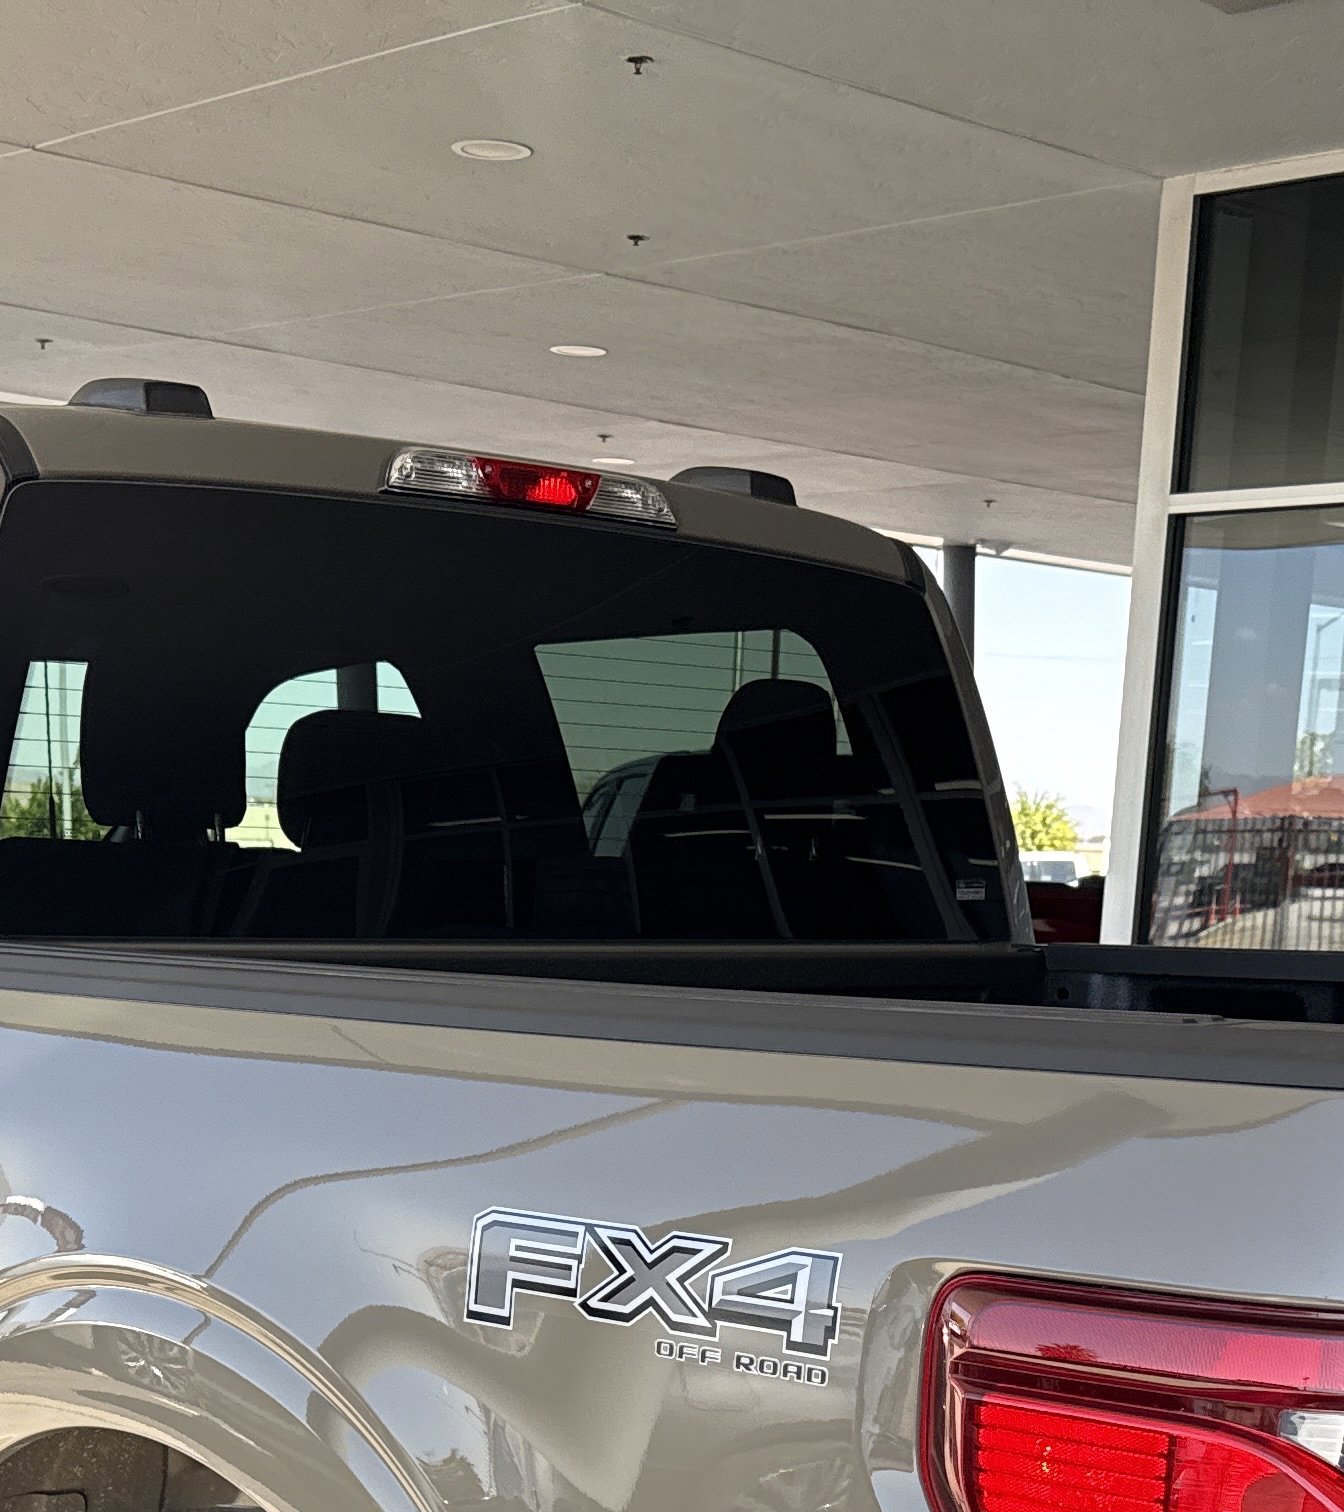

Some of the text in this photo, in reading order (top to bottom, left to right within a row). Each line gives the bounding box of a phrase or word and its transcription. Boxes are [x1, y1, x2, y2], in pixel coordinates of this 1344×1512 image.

[464, 1206, 843, 1360] FX4
[655, 1339, 829, 1386] OFF ROAD
